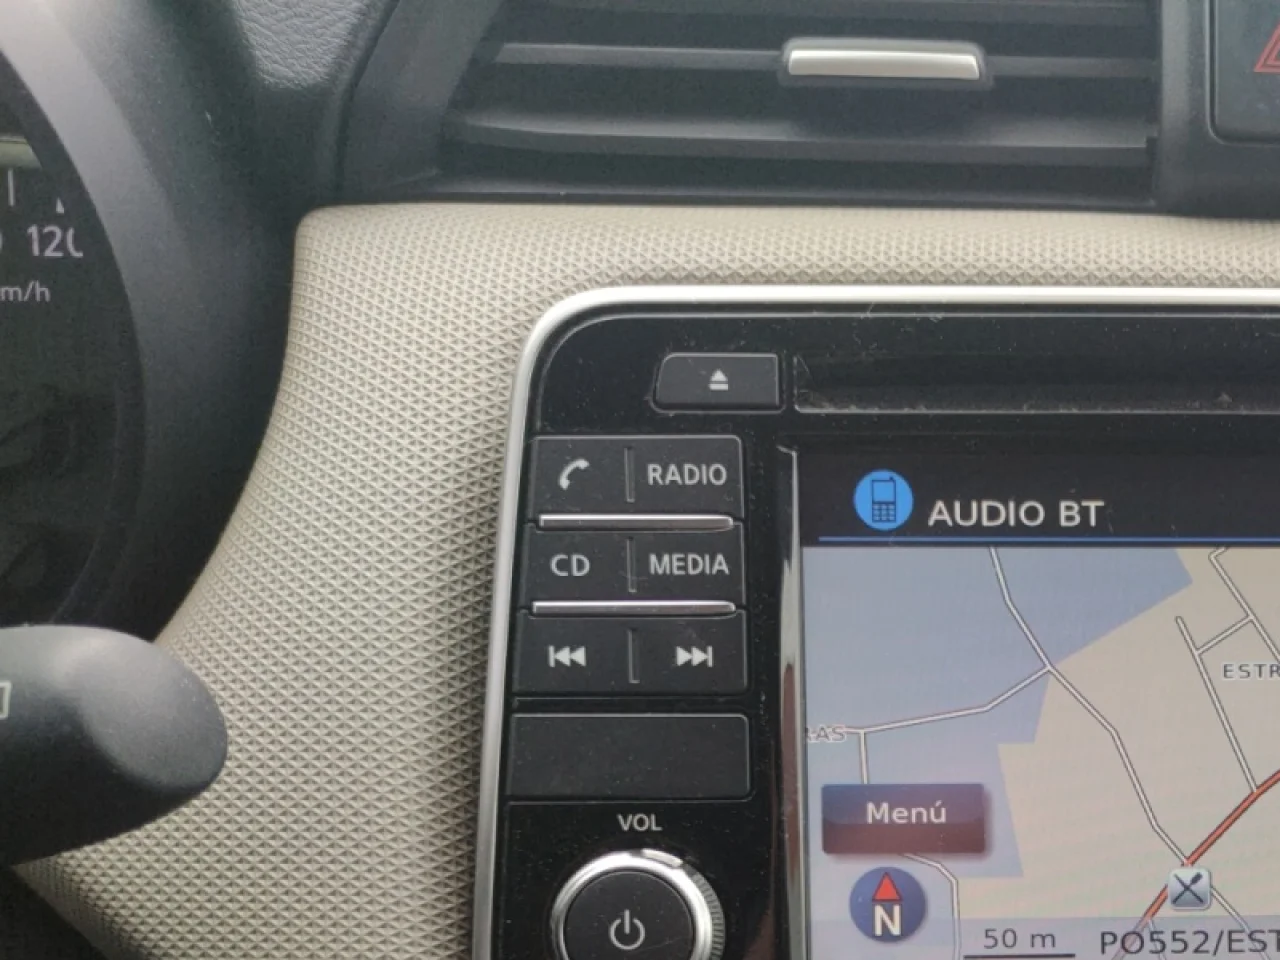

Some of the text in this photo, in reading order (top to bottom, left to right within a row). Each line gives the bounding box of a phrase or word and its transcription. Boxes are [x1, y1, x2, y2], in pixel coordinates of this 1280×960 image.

[0, 280, 51, 302] m/h
[646, 463, 728, 487] RADIO
[927, 500, 1106, 528] AUDIO BT
[550, 555, 591, 578] CD
[648, 552, 730, 577] MEDIA
[617, 814, 662, 833] VOL
[866, 801, 948, 826] Menú
[873, 902, 903, 936] N
[982, 928, 1057, 951] 50 m
